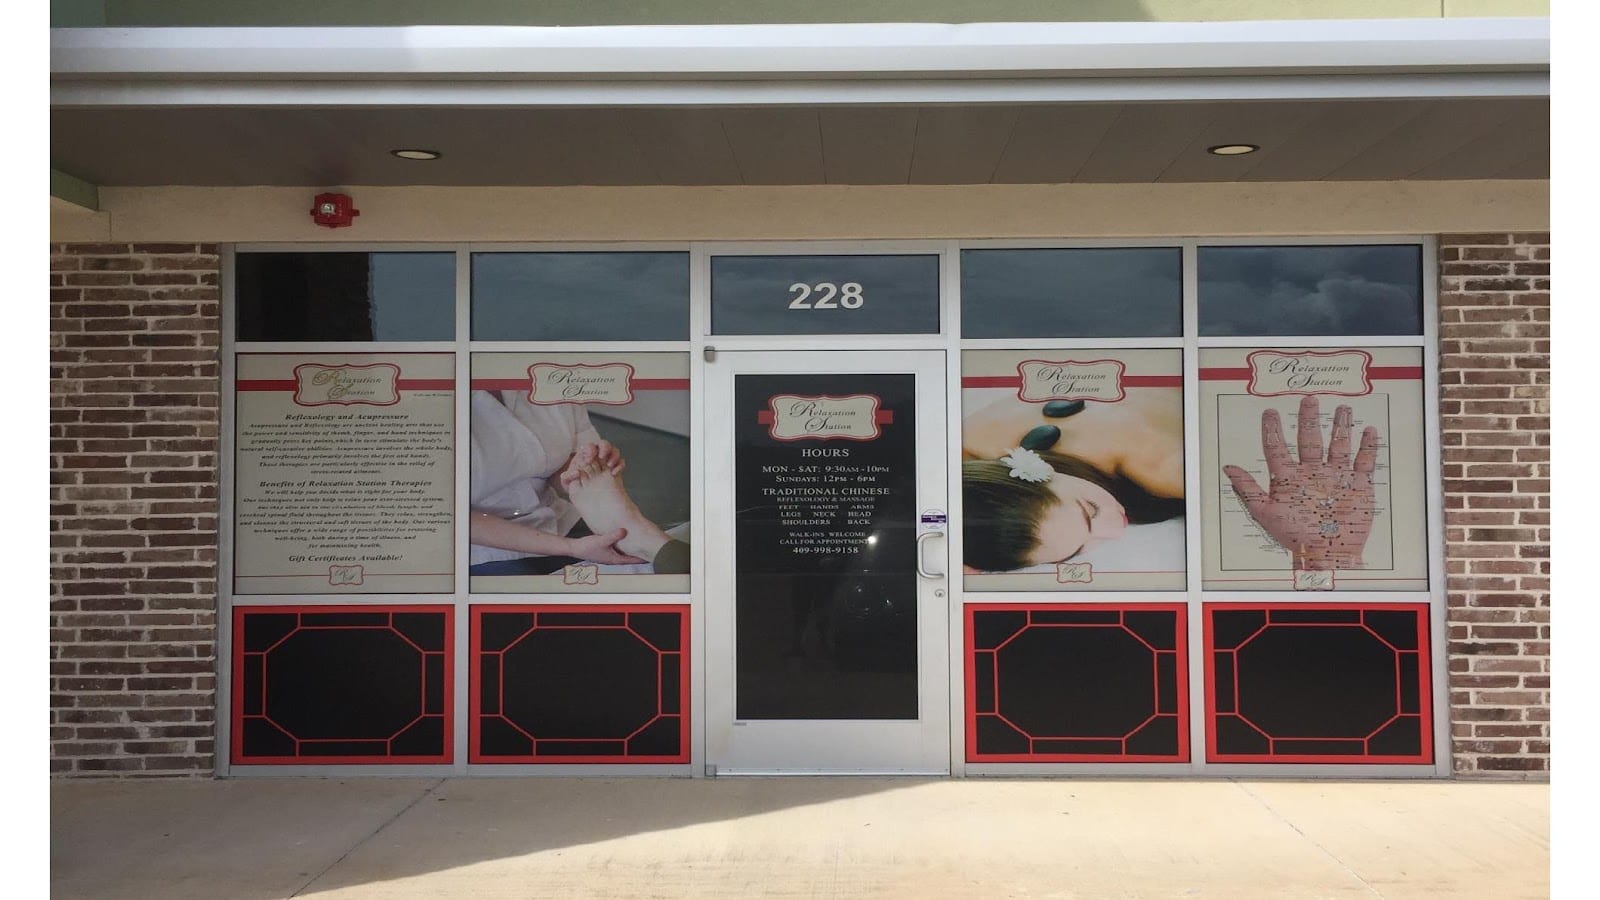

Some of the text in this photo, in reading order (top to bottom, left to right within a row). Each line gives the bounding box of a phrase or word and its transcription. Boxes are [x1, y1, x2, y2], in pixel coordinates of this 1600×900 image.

[788, 282, 864, 309] 228
[1269, 358, 1350, 374] Relaxation
[547, 368, 616, 384] Relaxation
[1037, 367, 1106, 381] Relaxation
[1287, 373, 1343, 388] Station
[562, 384, 609, 398] Station
[1052, 381, 1100, 394] Station
[789, 401, 856, 418] Relaxation
[804, 416, 852, 432] Station
[802, 448, 850, 457] HOURS
[762, 465, 788, 473] MON
[798, 465, 821, 473] SAT:
[824, 465, 859, 473] 9:30AM
[259, 480, 294, 488] Benefits
[297, 480, 307, 488] of
[390, 480, 432, 488] Therapies
[775, 475, 819, 483] SUNDAYS:
[823, 475, 847, 483] 12PM
[857, 475, 875, 483] 6PM
[762, 488, 890, 496] TRADITIONAL CHINESE
[792, 546, 859, 554] 409-998-9158
[288, 554, 305, 562] Gift
